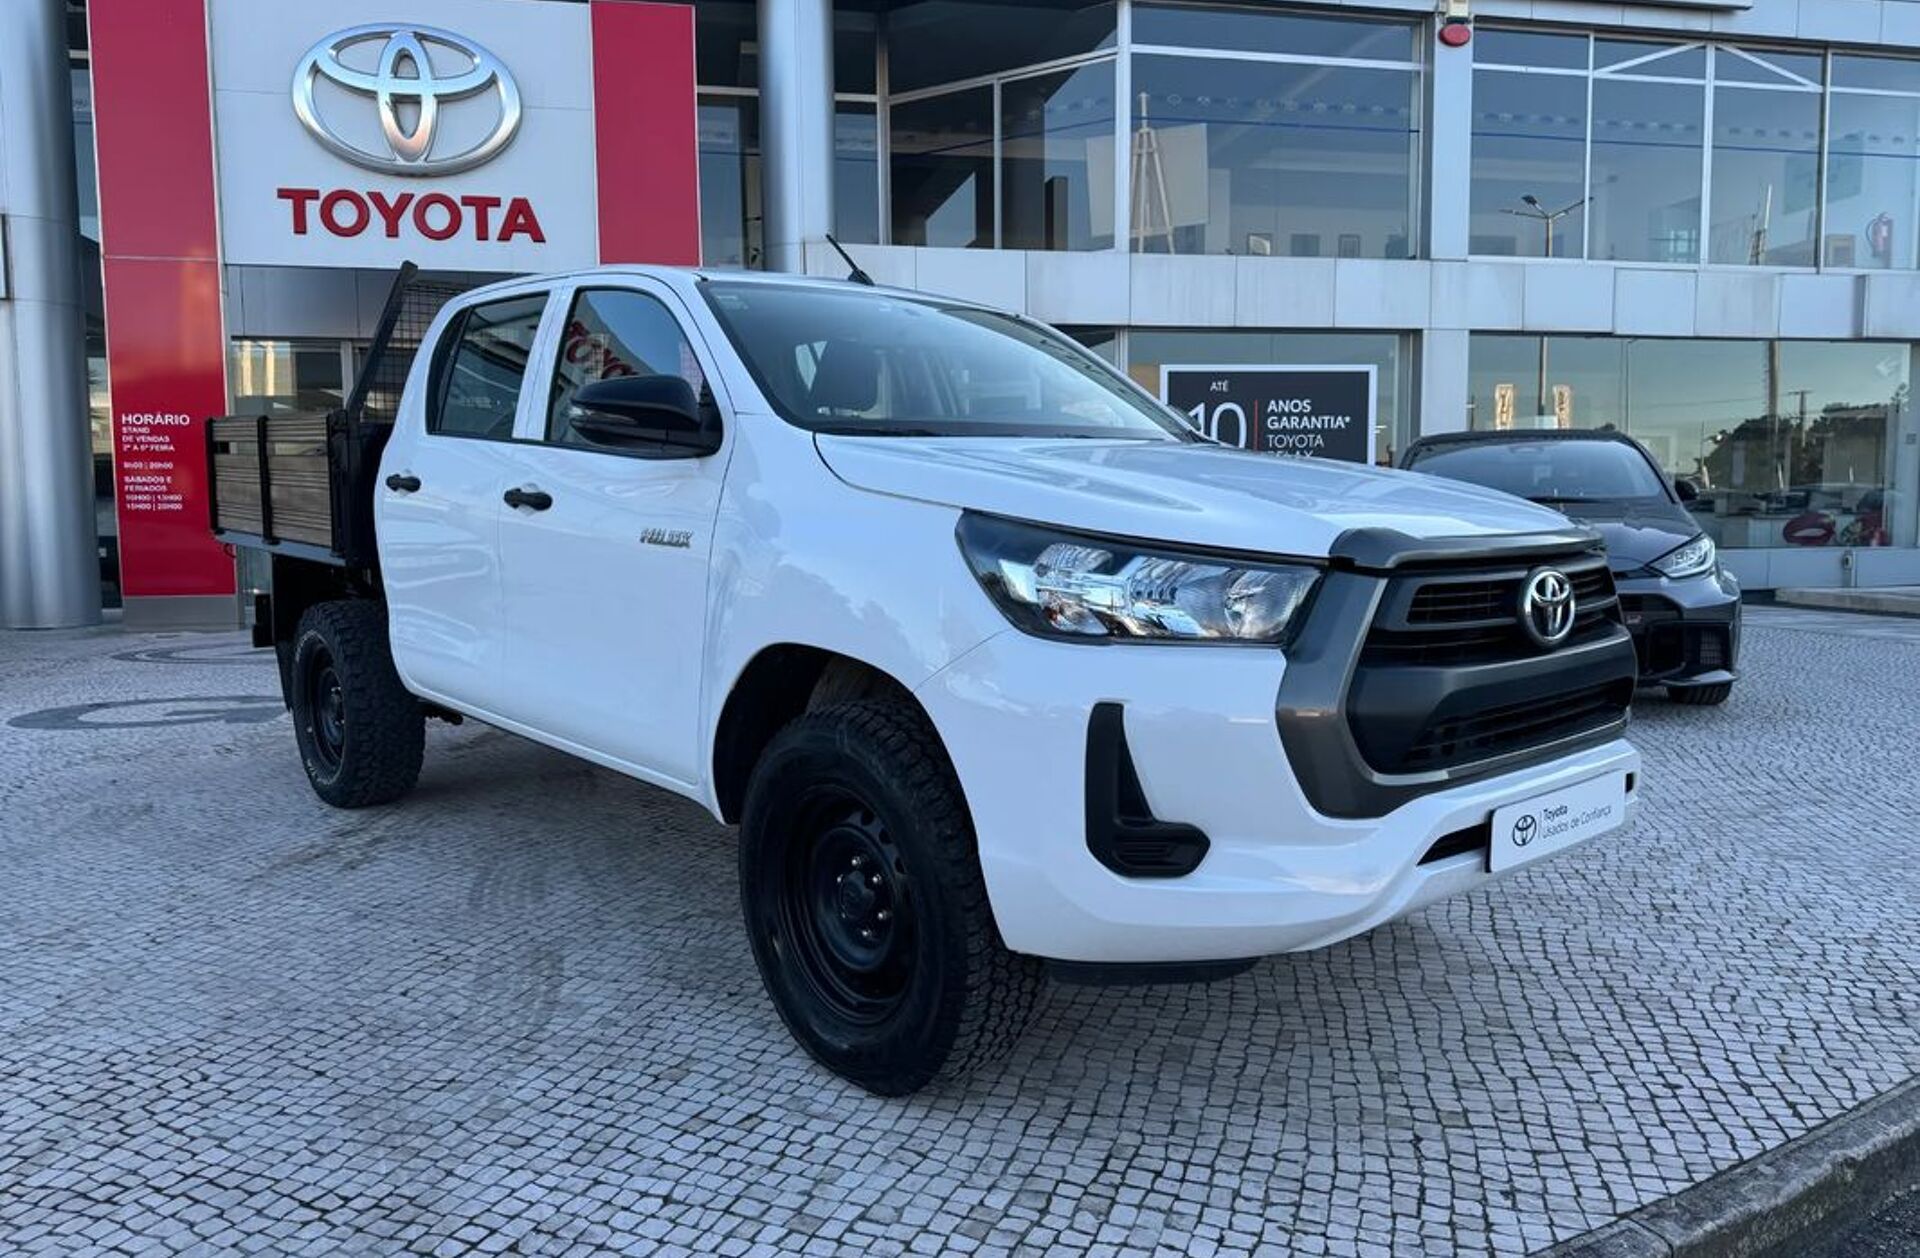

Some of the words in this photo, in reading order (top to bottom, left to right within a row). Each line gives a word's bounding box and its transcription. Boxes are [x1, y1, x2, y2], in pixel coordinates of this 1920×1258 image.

[277, 188, 546, 243] TOYOTA
[1210, 380, 1228, 392] ATÉ
[1267, 400, 1312, 413] ANOS
[122, 412, 190, 425] HORÁRIO
[1267, 434, 1325, 448] TOYOTA
[1543, 805, 1568, 822] Toyota
